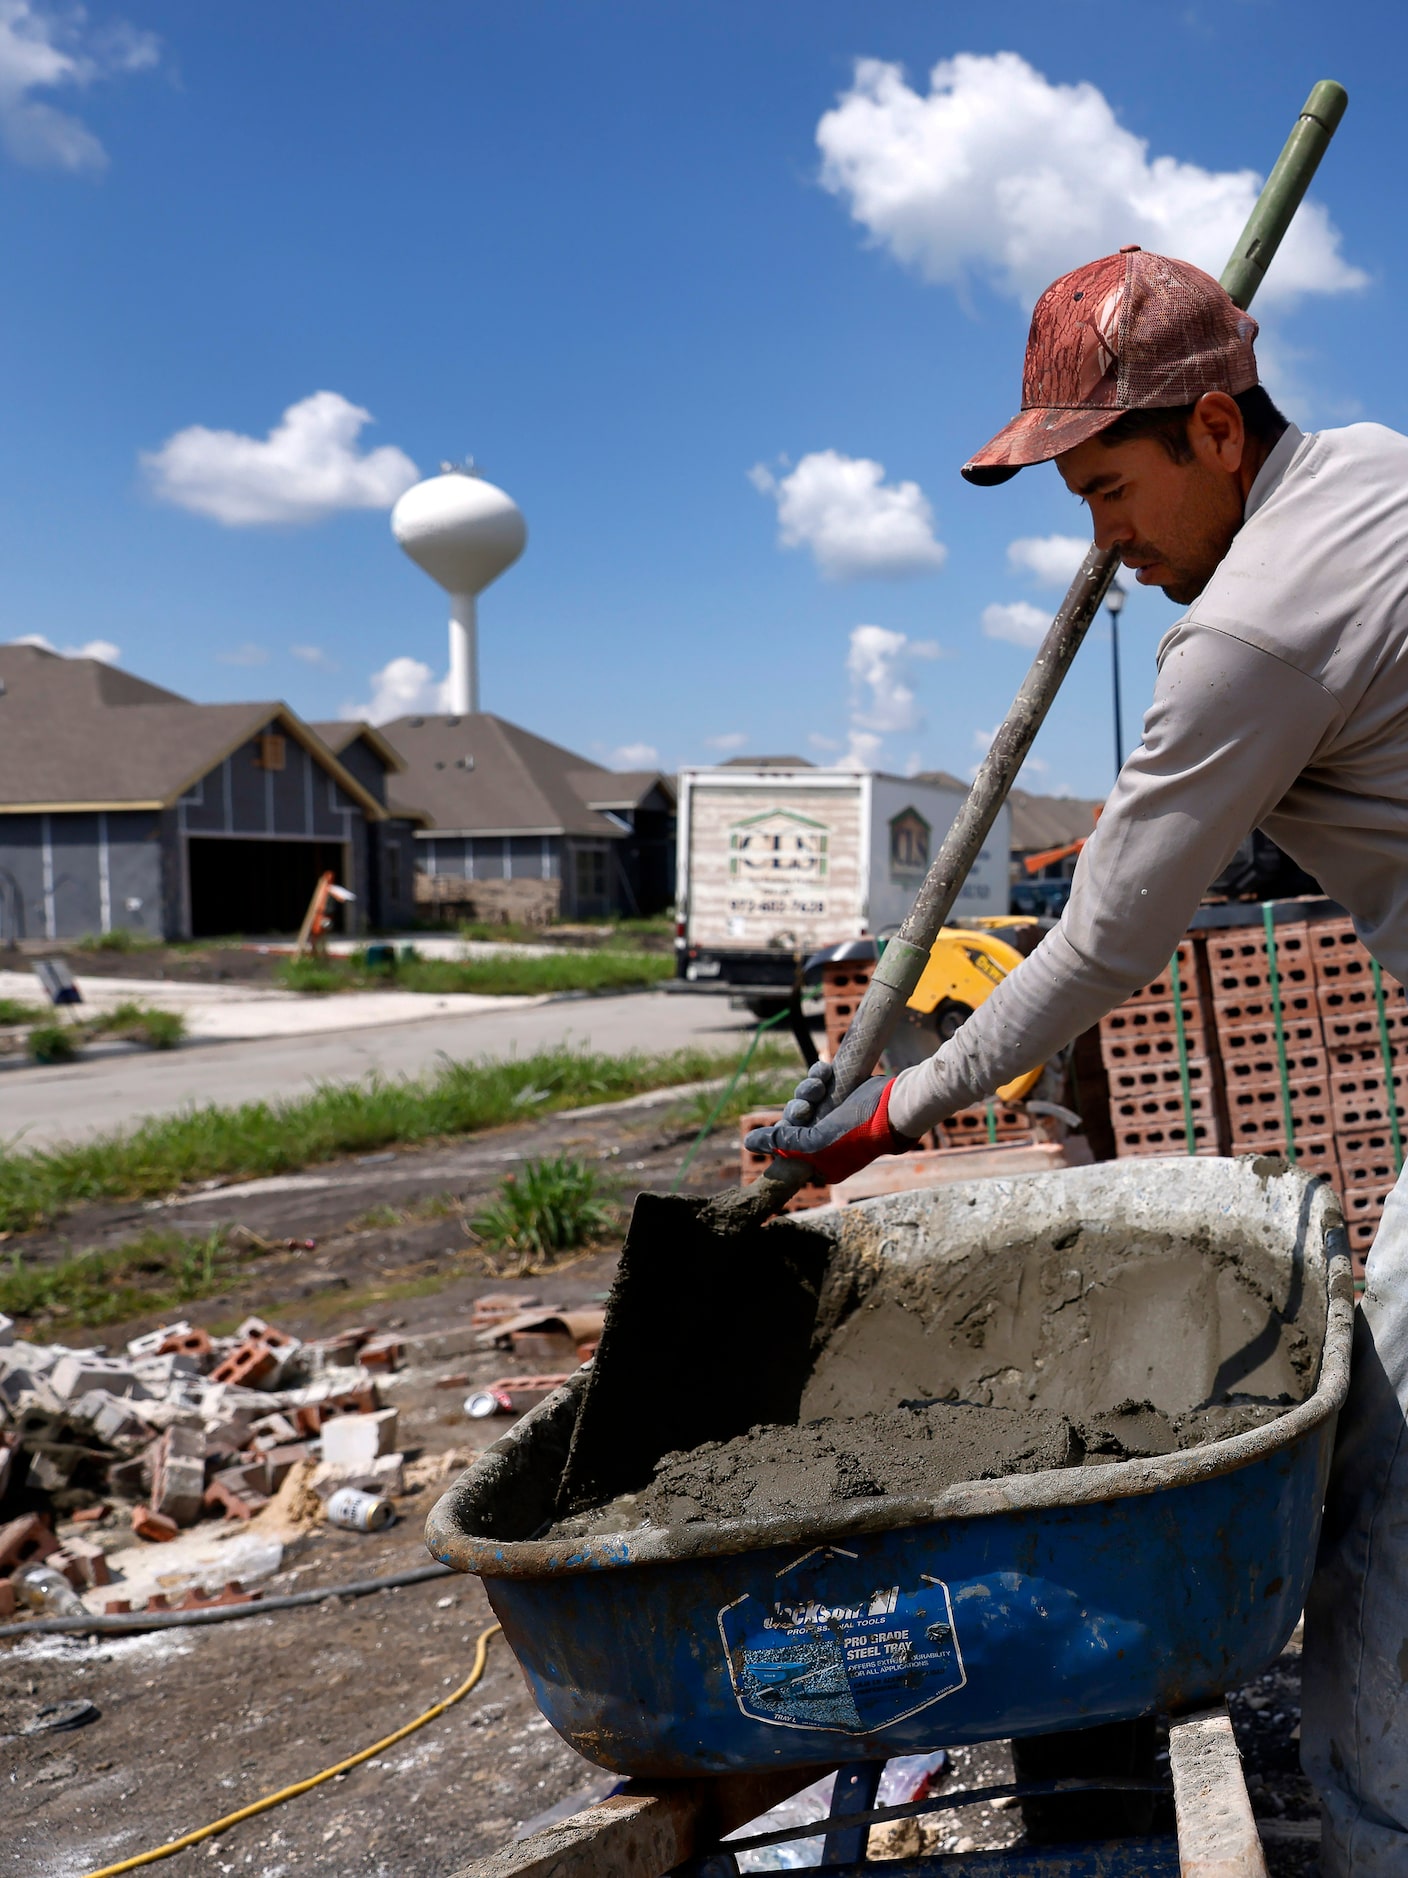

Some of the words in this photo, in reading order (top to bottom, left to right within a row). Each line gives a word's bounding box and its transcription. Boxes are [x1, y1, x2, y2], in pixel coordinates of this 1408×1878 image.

[857, 1617, 886, 1627] TOOLS
[844, 1635, 867, 1649] PRO
[870, 1630, 909, 1644] GRADE
[847, 1646, 881, 1661] STEEL
[884, 1641, 912, 1655] TRAY
[847, 1661, 876, 1672] OFFERS
[866, 1668, 880, 1676] ALL
[880, 1660, 929, 1673] APPLICATIONS
